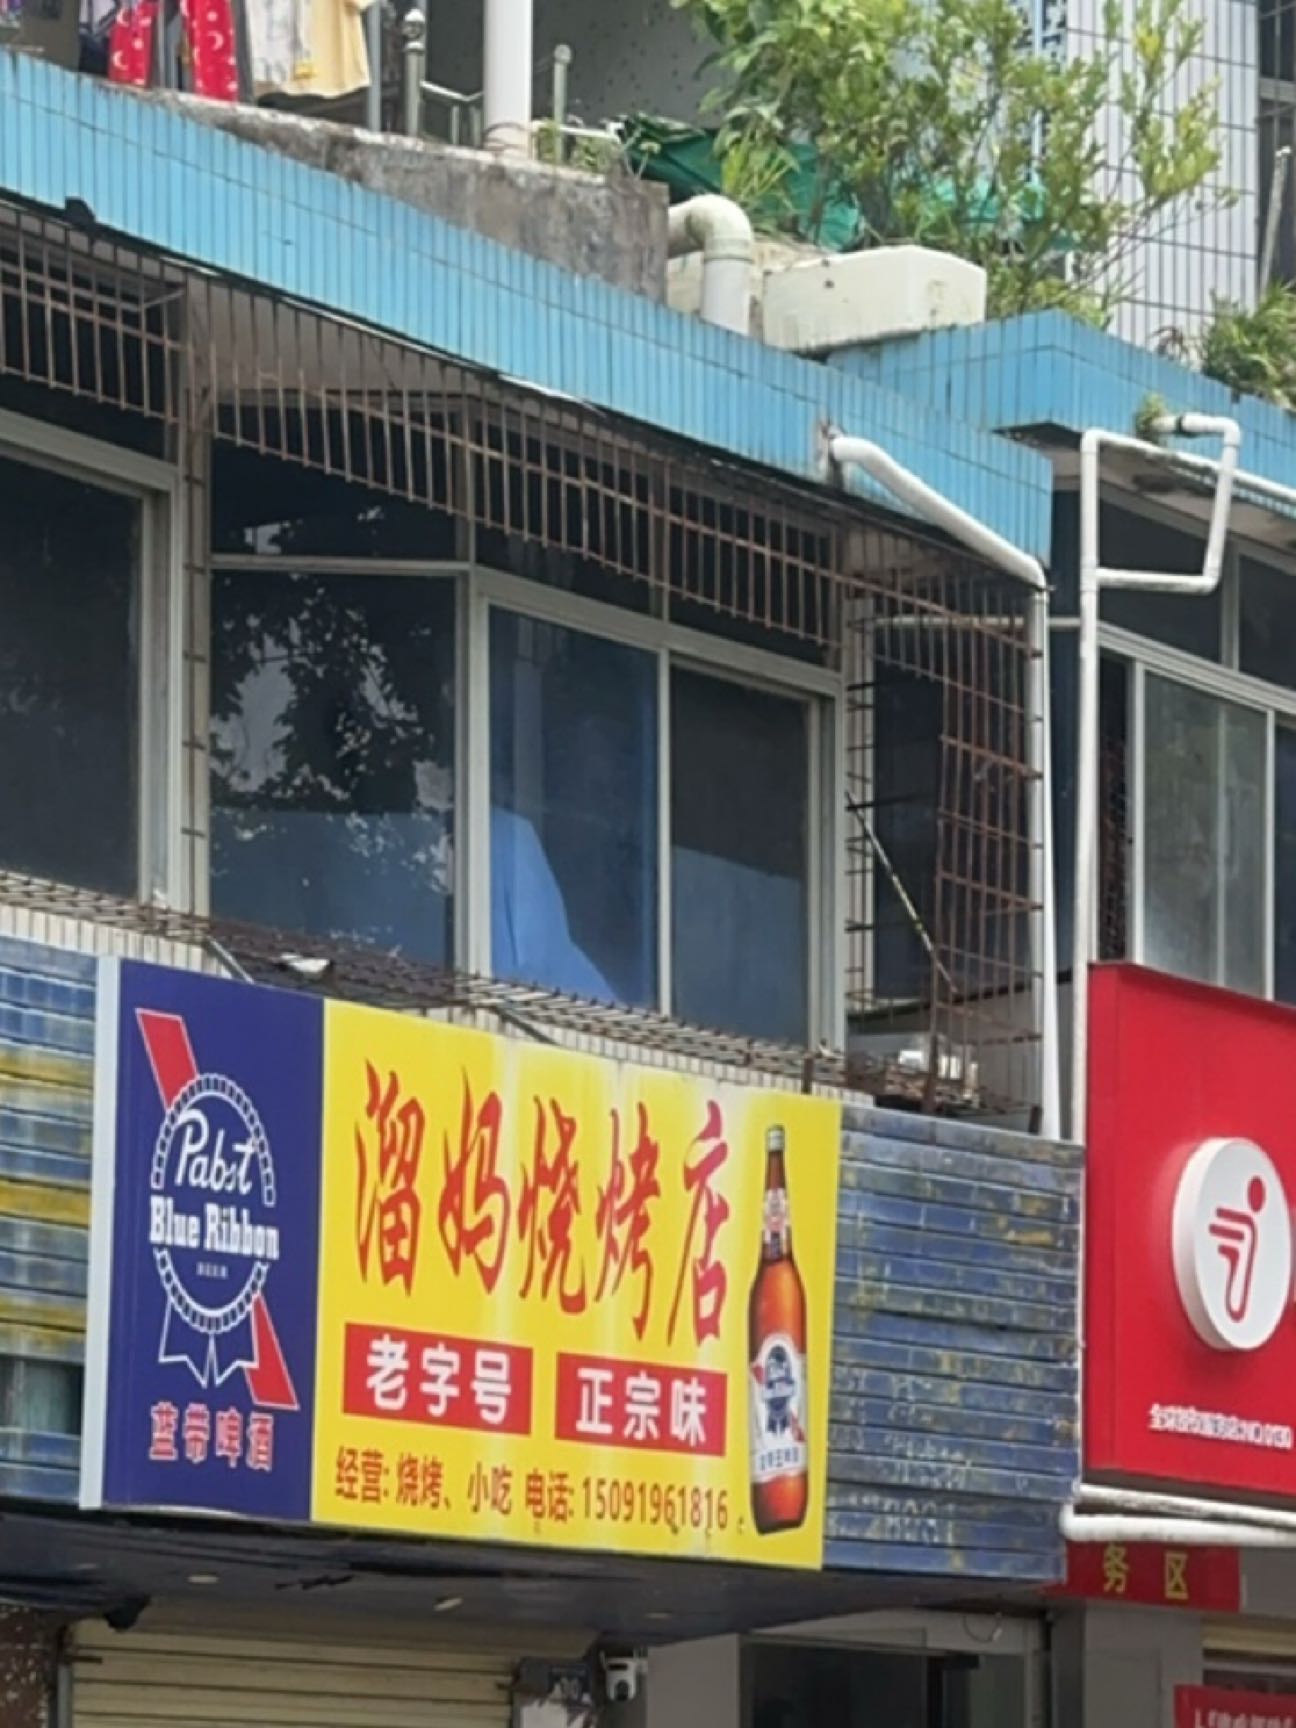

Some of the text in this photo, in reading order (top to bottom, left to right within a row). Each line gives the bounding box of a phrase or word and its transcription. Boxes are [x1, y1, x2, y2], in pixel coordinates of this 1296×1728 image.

[174, 1108, 260, 1196] Pabst
[149, 1194, 280, 1261] Blue Ribbon
[355, 1058, 730, 1347] 溜妈烧烤店
[366, 1333, 512, 1426] 老字号
[575, 1367, 707, 1448] 正宗味
[149, 1401, 274, 1473] 蓝带啤酒
